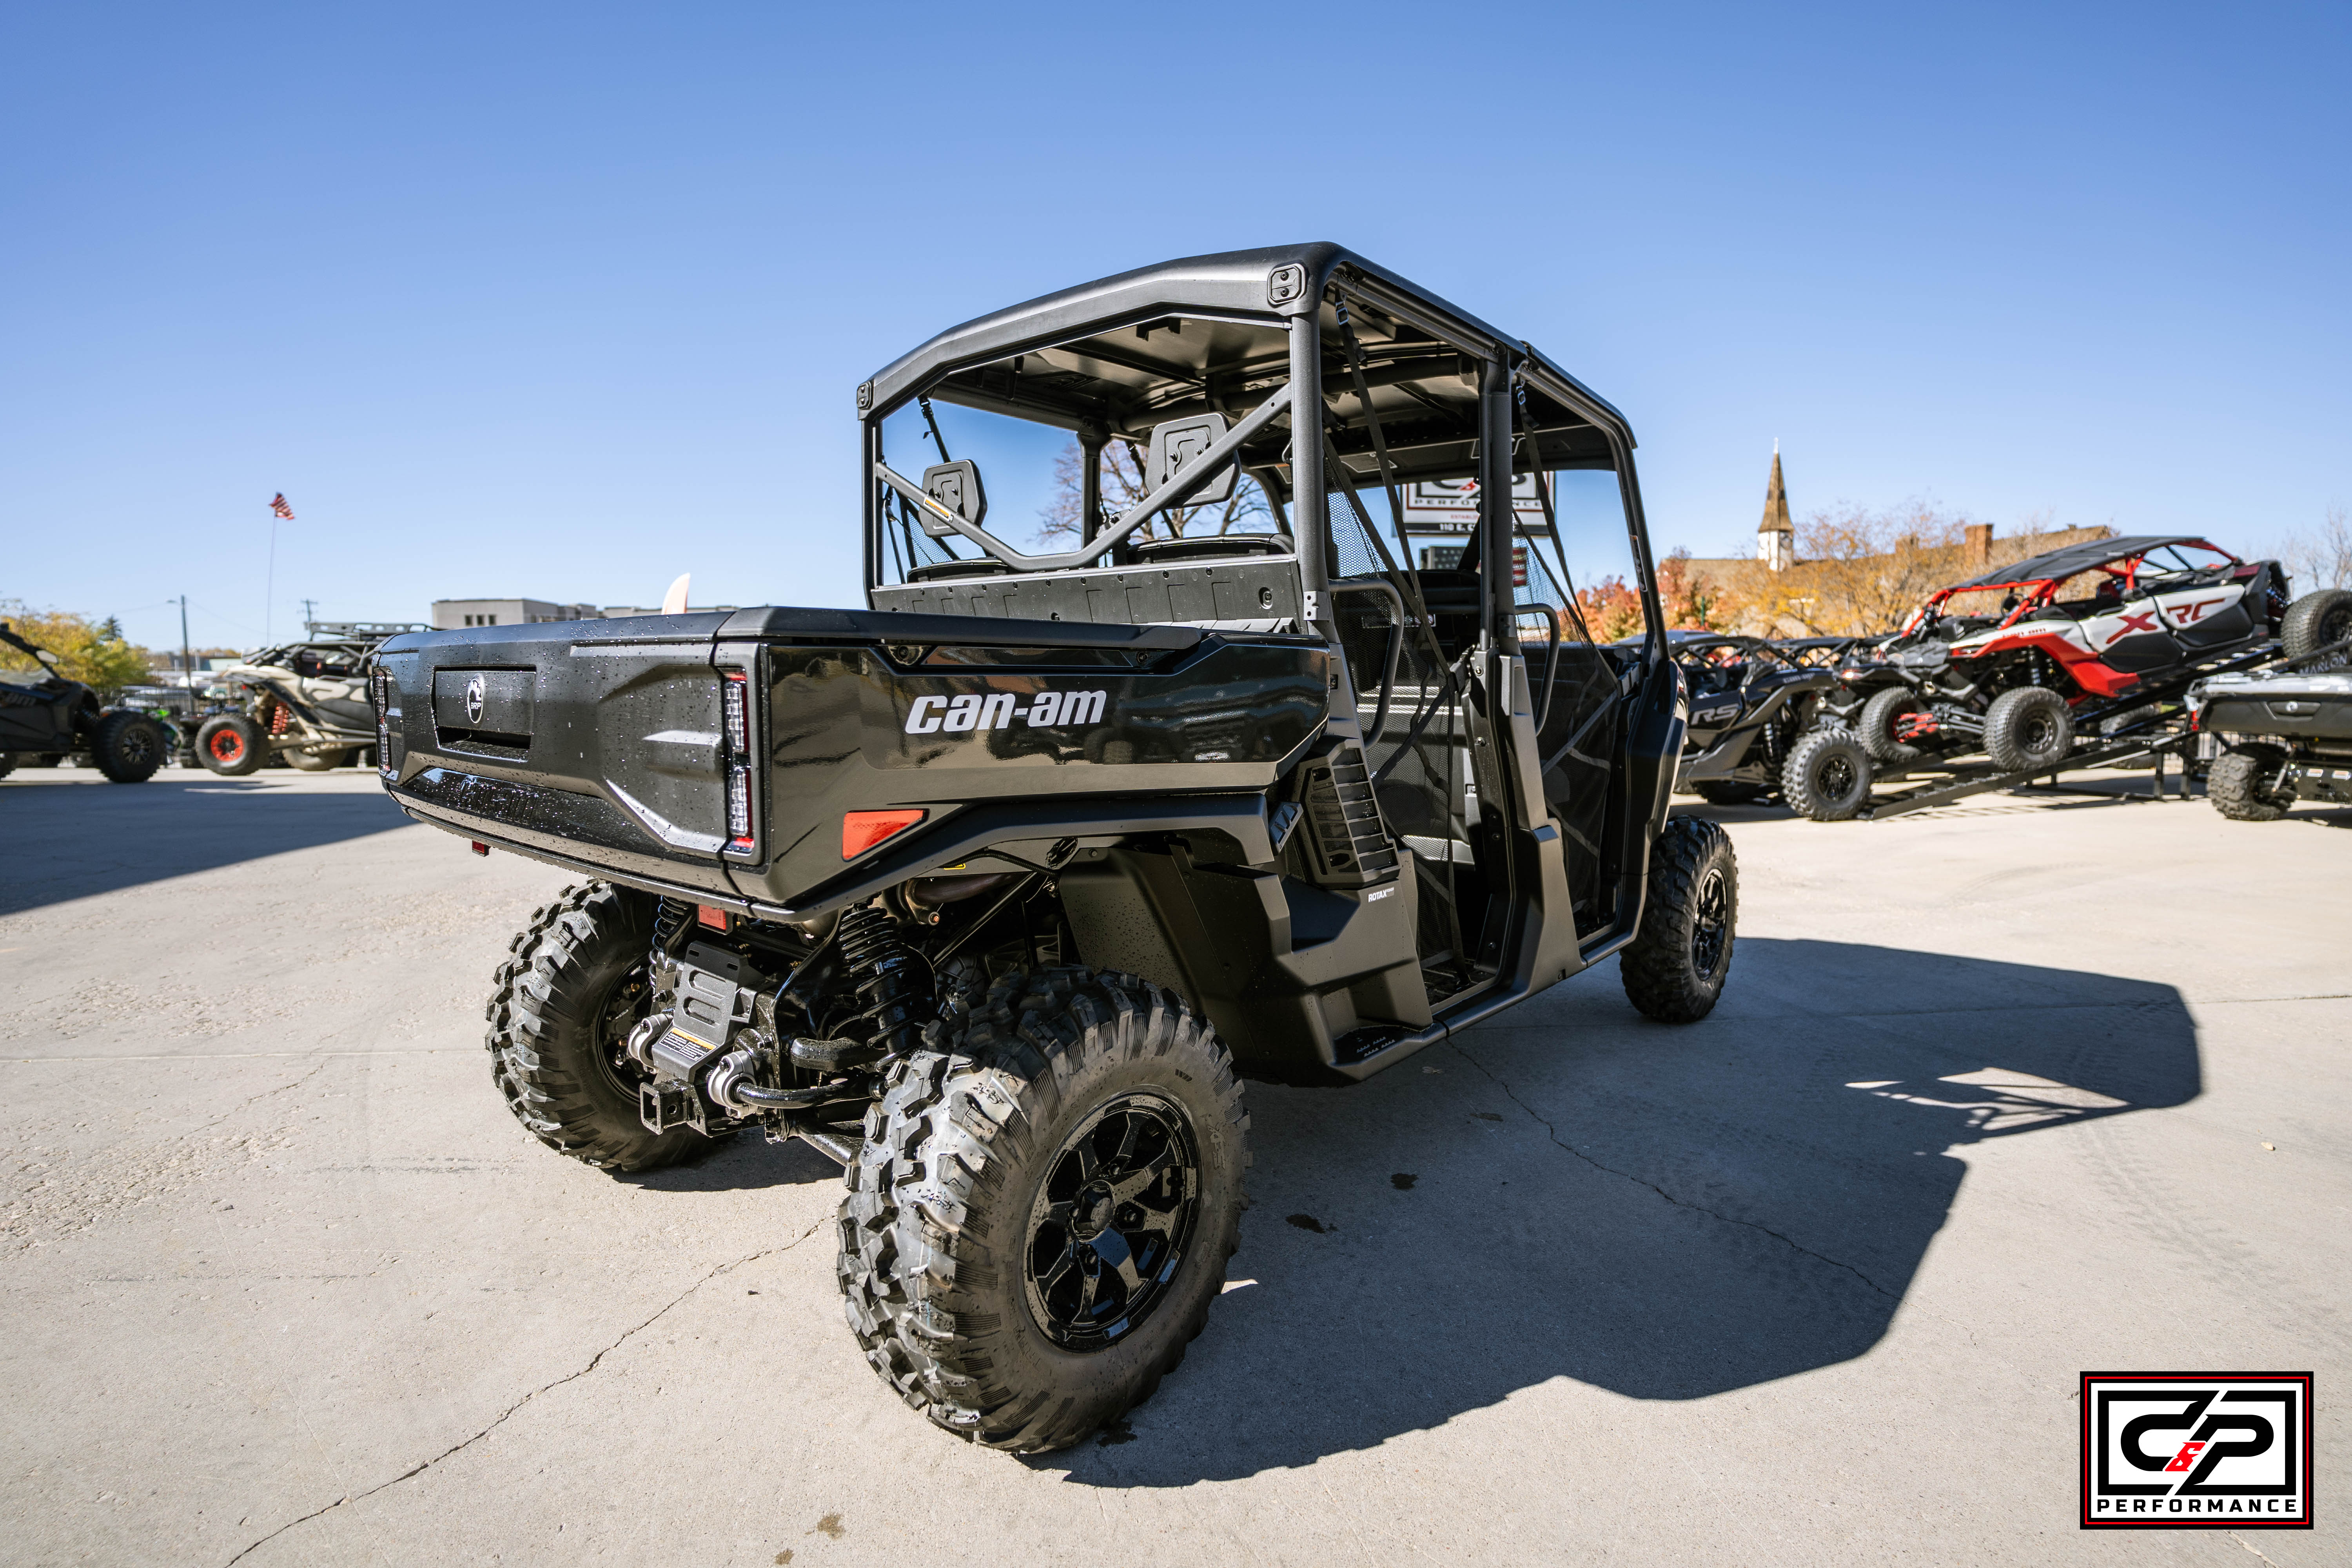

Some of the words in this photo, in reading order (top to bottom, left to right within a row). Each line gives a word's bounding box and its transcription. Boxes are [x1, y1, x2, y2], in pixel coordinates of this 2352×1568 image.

[905, 690, 1107, 734] can-am
[1690, 703, 1739, 726] RS
[1368, 889, 1387, 902] ROTAX
